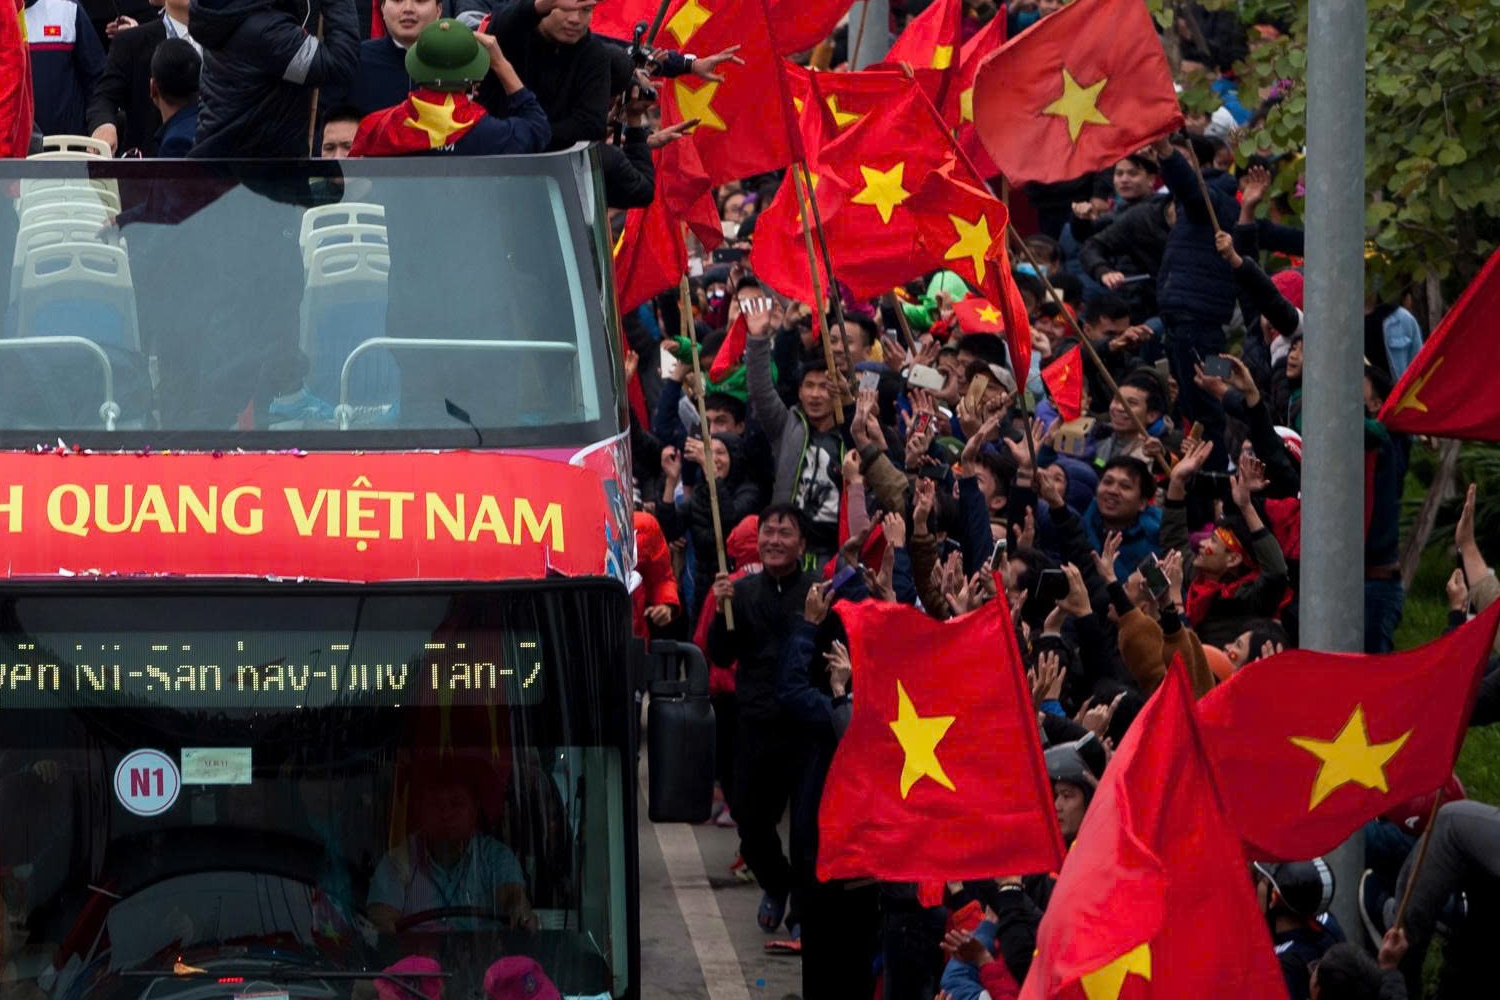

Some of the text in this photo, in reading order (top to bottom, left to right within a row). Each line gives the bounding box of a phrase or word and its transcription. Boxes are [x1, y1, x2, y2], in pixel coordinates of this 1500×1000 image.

[47, 483, 264, 537] QUANG
[283, 475, 415, 551] VIỆT
[425, 492, 565, 553] NAM
[130, 768, 164, 797] N1
